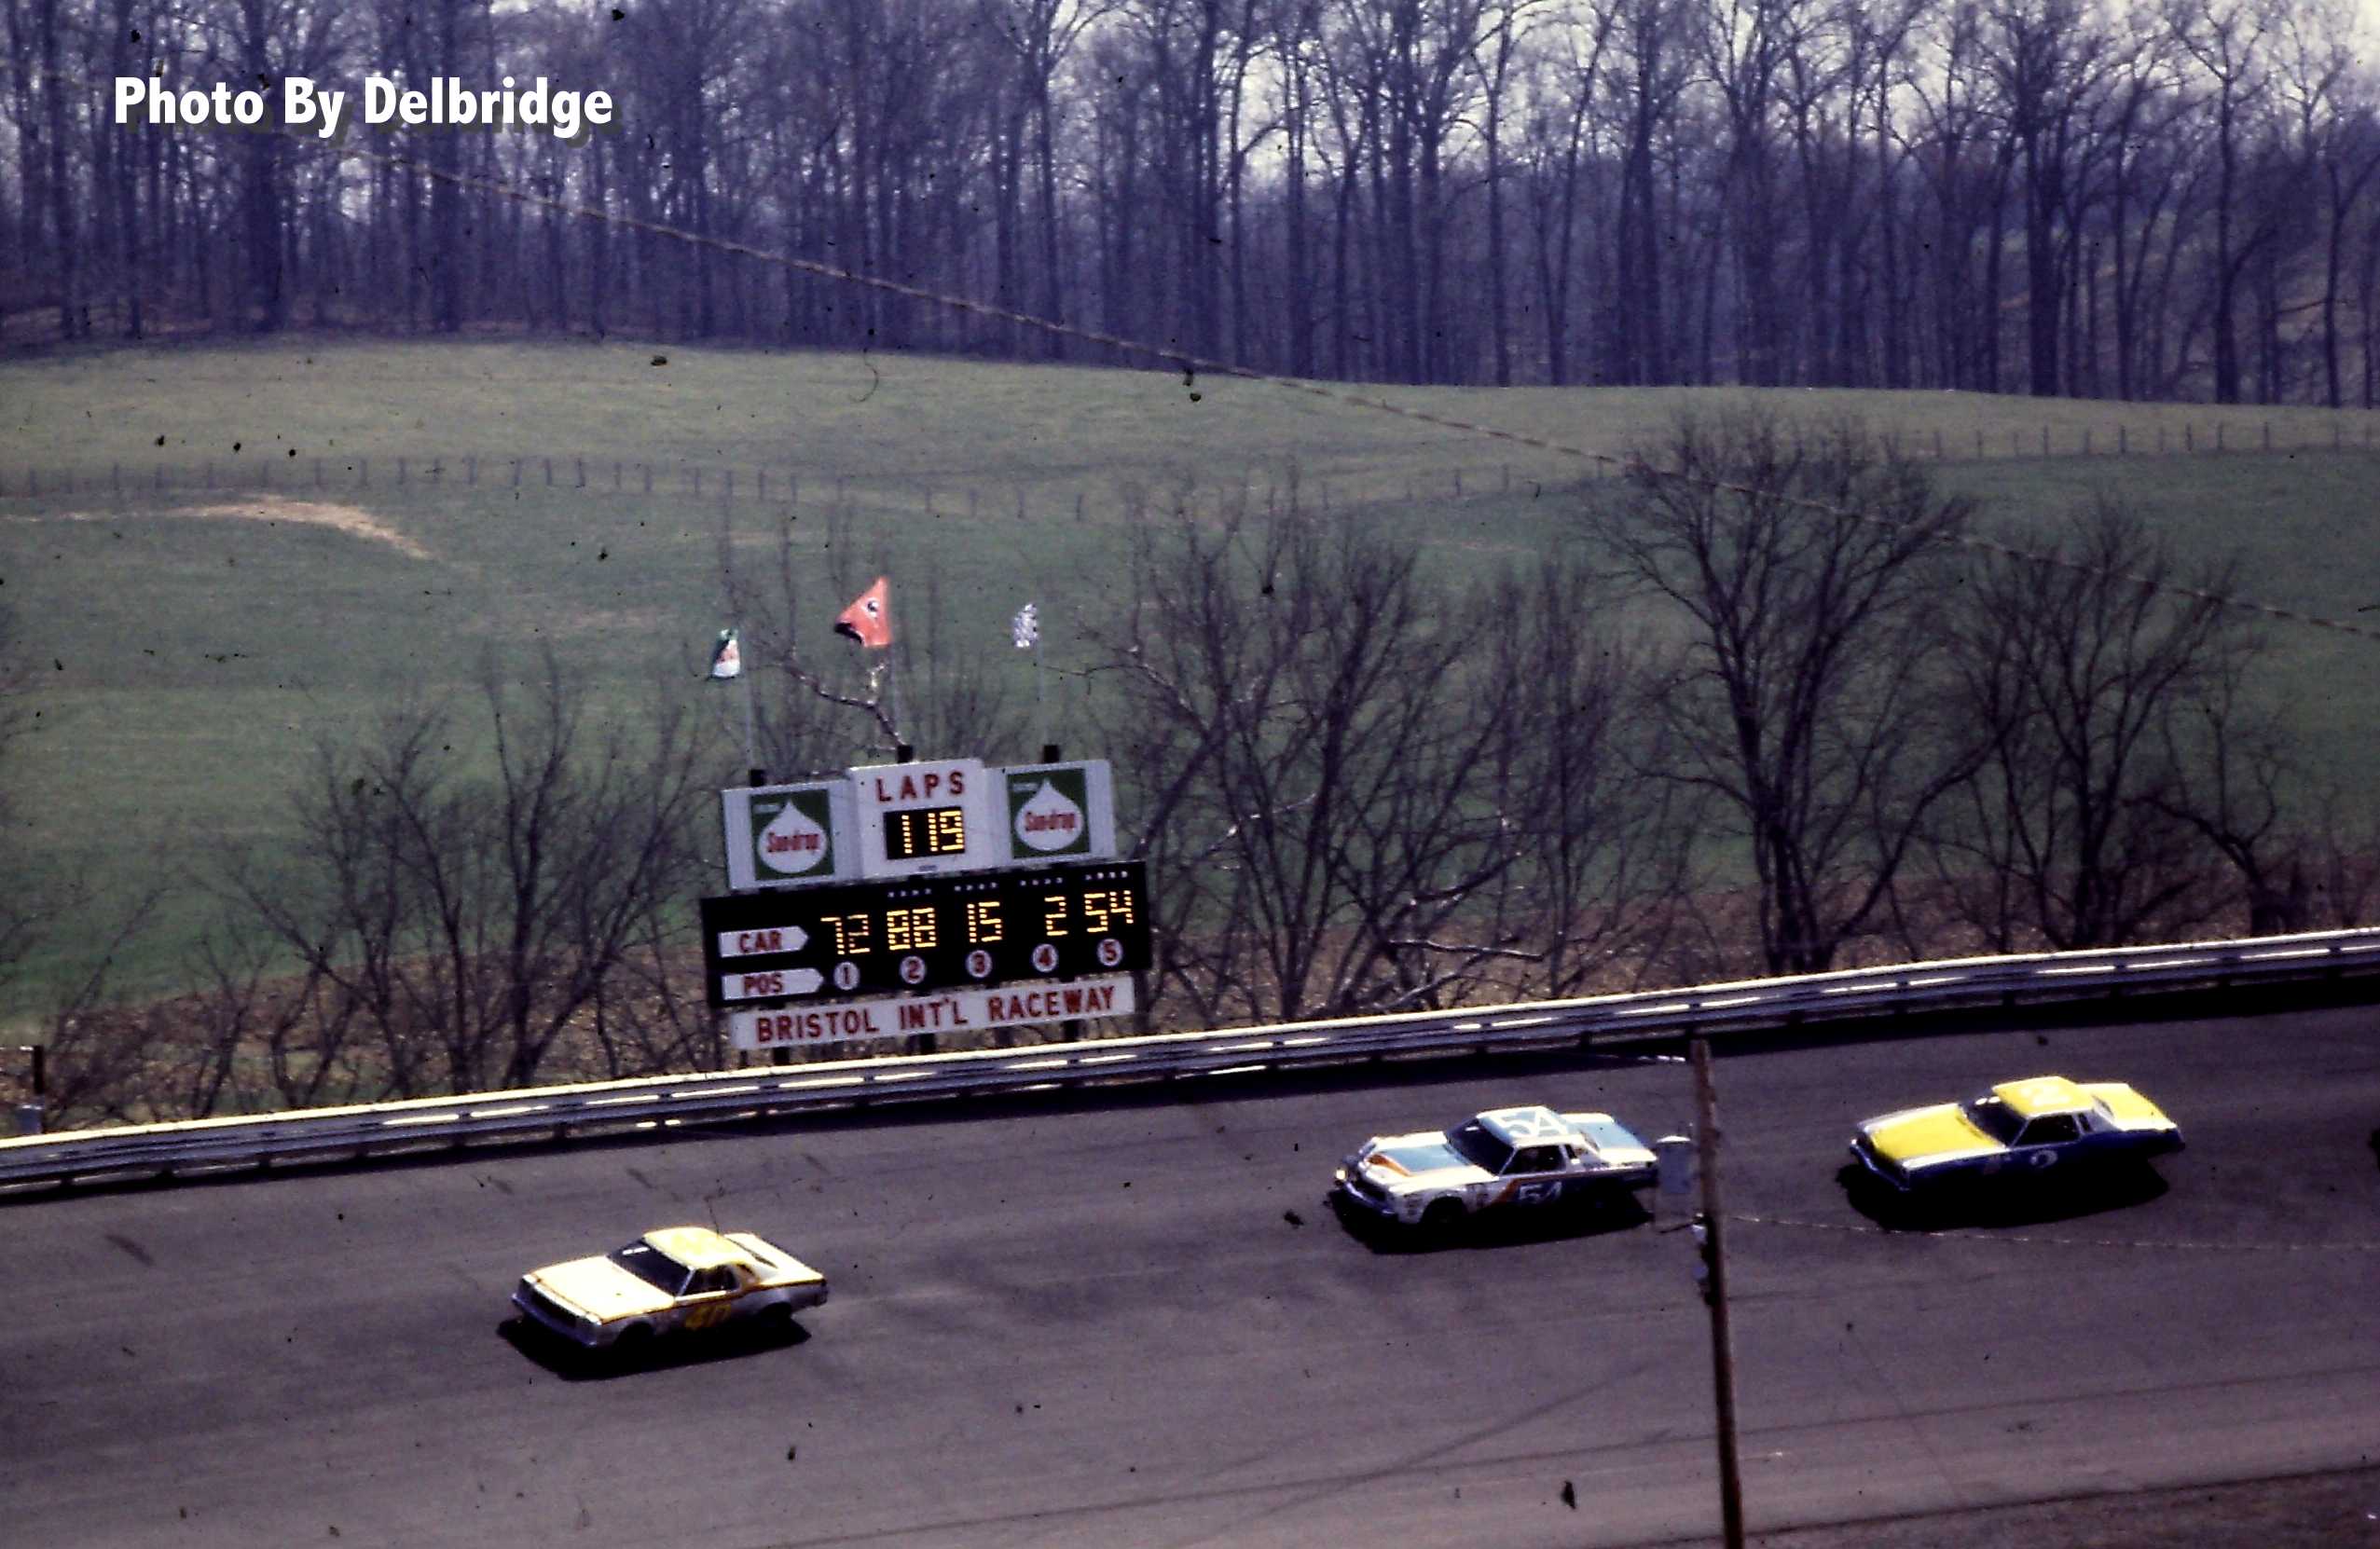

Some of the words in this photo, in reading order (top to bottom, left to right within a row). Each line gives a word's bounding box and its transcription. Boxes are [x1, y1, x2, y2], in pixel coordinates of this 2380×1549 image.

[876, 772, 964, 802] LAPS
[901, 810, 964, 855] 119
[820, 914, 871, 955] 72
[887, 907, 936, 951] 88
[967, 901, 1002, 943] 15
[1044, 896, 1068, 936] 2
[1084, 890, 1134, 933] 54
[739, 929, 782, 954] CAR
[743, 973, 783, 998] POS
[757, 1008, 880, 1043] BRISTOL
[899, 996, 968, 1030] INT'L
[988, 985, 1114, 1021] RACEWAY
